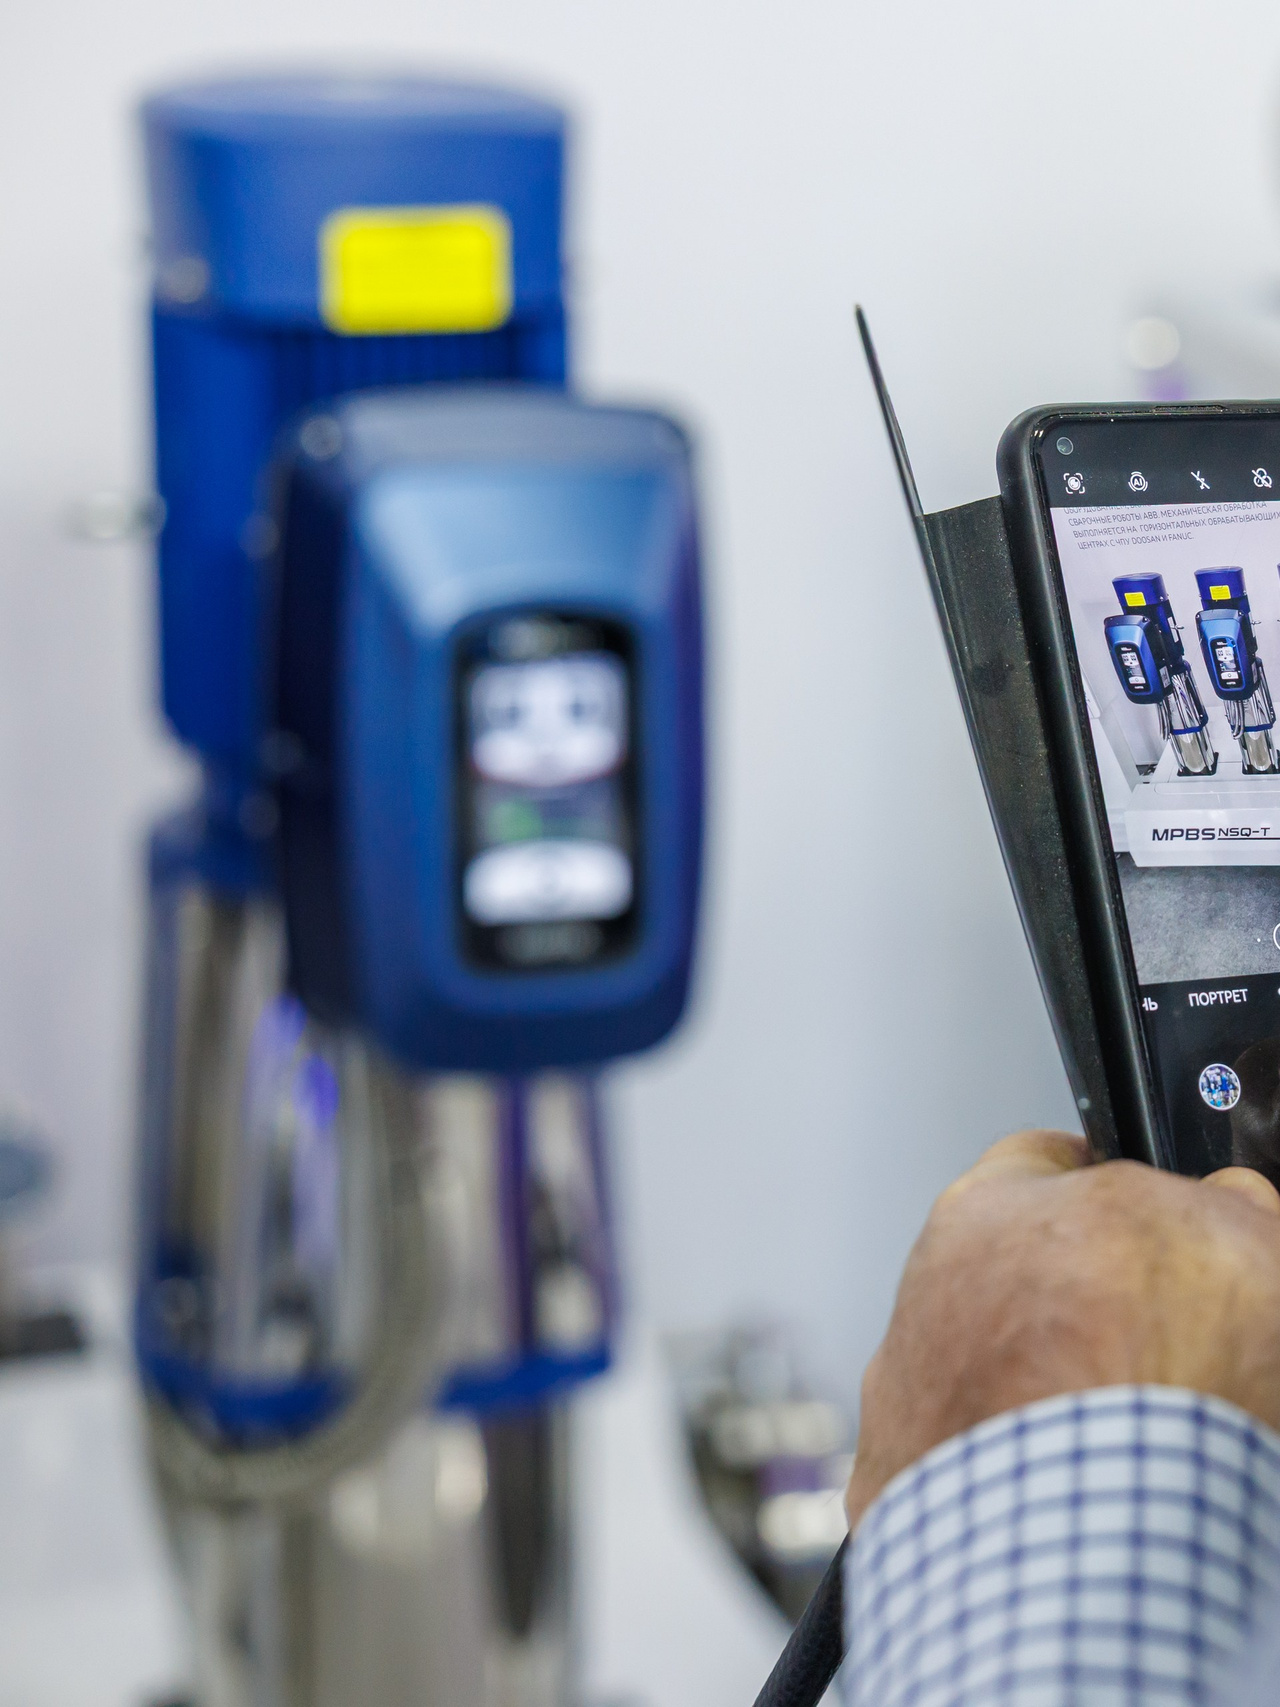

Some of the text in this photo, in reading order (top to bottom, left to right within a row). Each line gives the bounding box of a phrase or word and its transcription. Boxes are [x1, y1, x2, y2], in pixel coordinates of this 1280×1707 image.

[1068, 515, 1112, 527] СВАРОЧНЫЕ
[1113, 512, 1141, 523] РОБОТЫ
[1160, 504, 1222, 518] МЕХАНИЧЕСКАЯ
[1223, 501, 1267, 512] ОБРАБОТКА
[1073, 526, 1126, 539] ВЫПОЛНЯЕТСЯ
[1126, 525, 1138, 533] НА
[1139, 518, 1207, 532] ГОРИЗОНТАЛЬНЫХ
[1077, 531, 1194, 550] ЦЕНТРАХ С ЧПУ DOOSAN И FANUC.
[1152, 826, 1271, 842] MPBS NSQ-T
[1188, 988, 1249, 1007] ПОРТРЕТ
